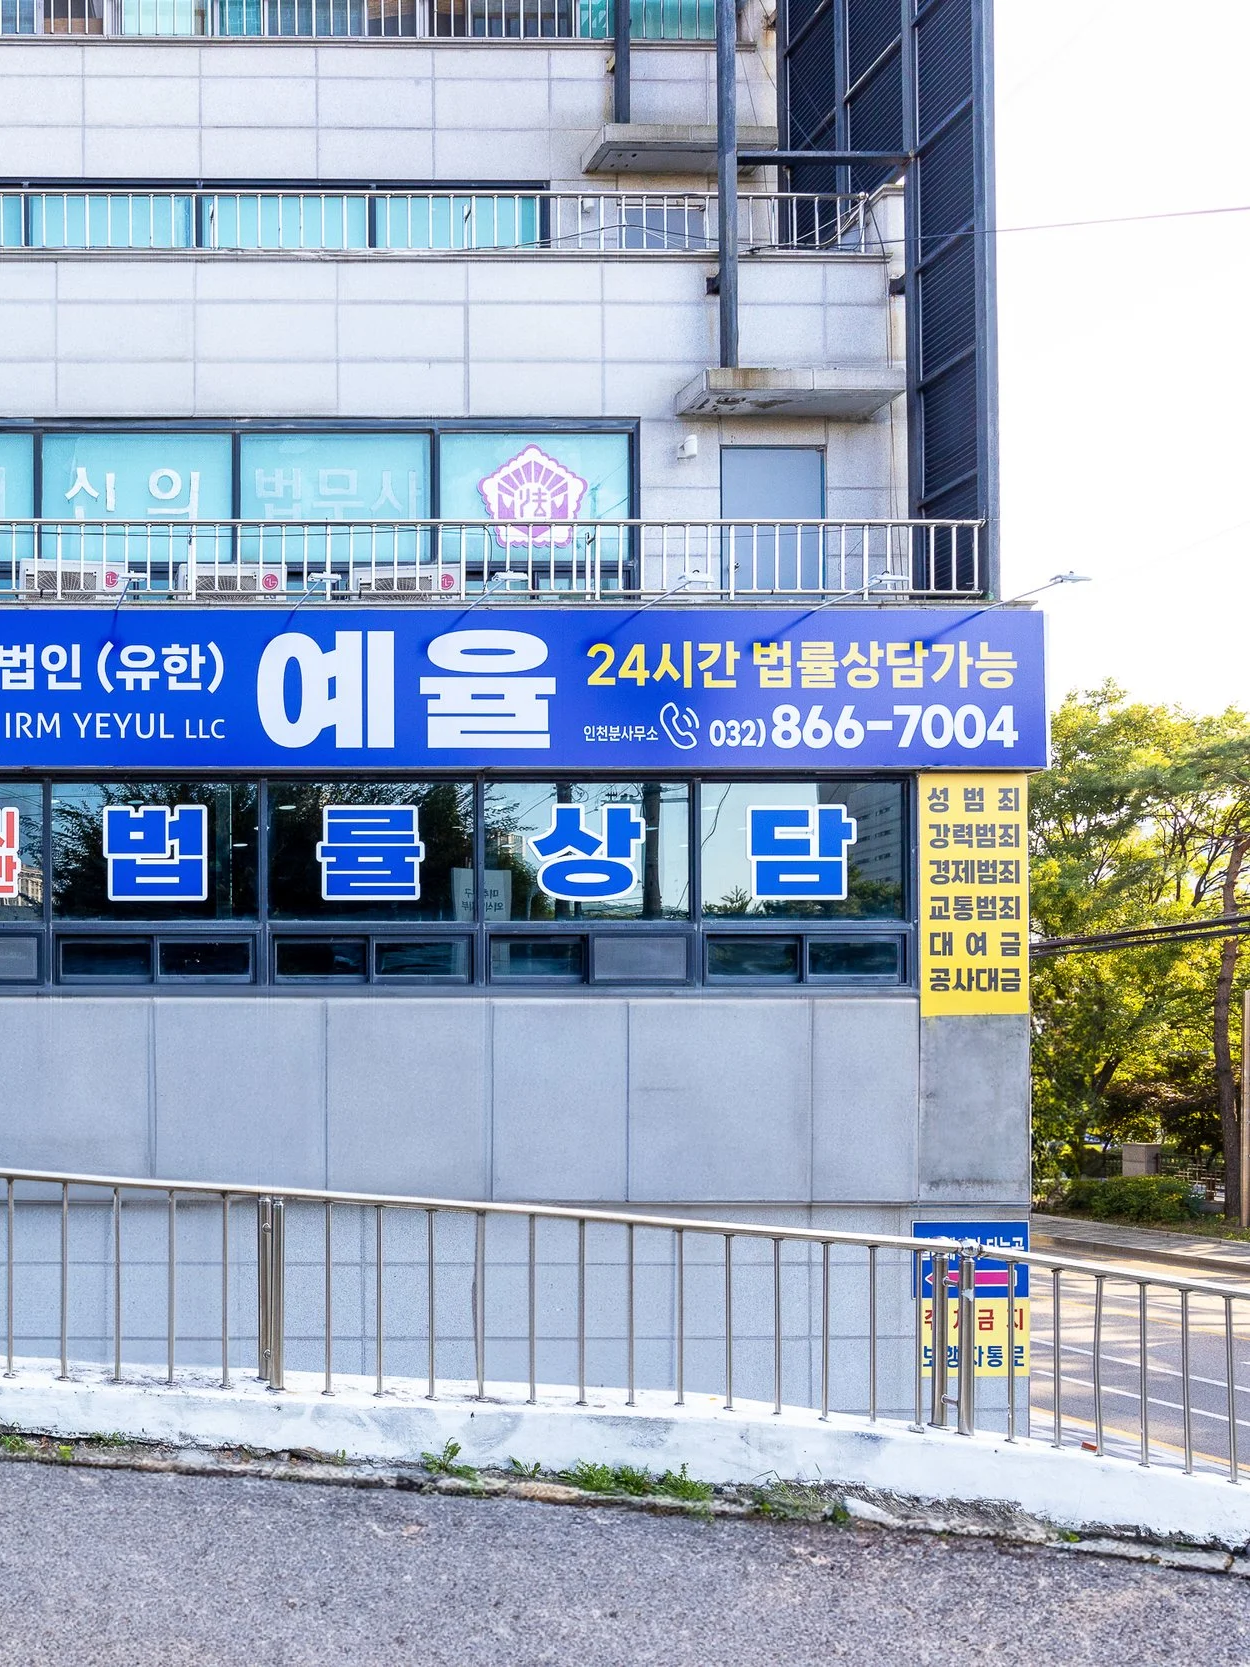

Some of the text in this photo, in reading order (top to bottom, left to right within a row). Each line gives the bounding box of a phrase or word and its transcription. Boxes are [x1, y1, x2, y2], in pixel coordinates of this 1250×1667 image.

[255, 468, 423, 520] 법무사
[97, 641, 225, 694] (유한)
[587, 640, 1017, 690] 24시간 법률상담가능
[256, 629, 556, 749] 예율
[73, 712, 174, 739] YEYUL
[185, 719, 225, 740] LLC
[583, 725, 658, 743] 인천분사무소
[709, 704, 1019, 749] 032) 866-7004
[929, 824, 1020, 848] 강력범죄
[929, 860, 1020, 884] 경제범죄
[929, 896, 1020, 920] 교통범죄
[930, 968, 1021, 992] 공사대금
